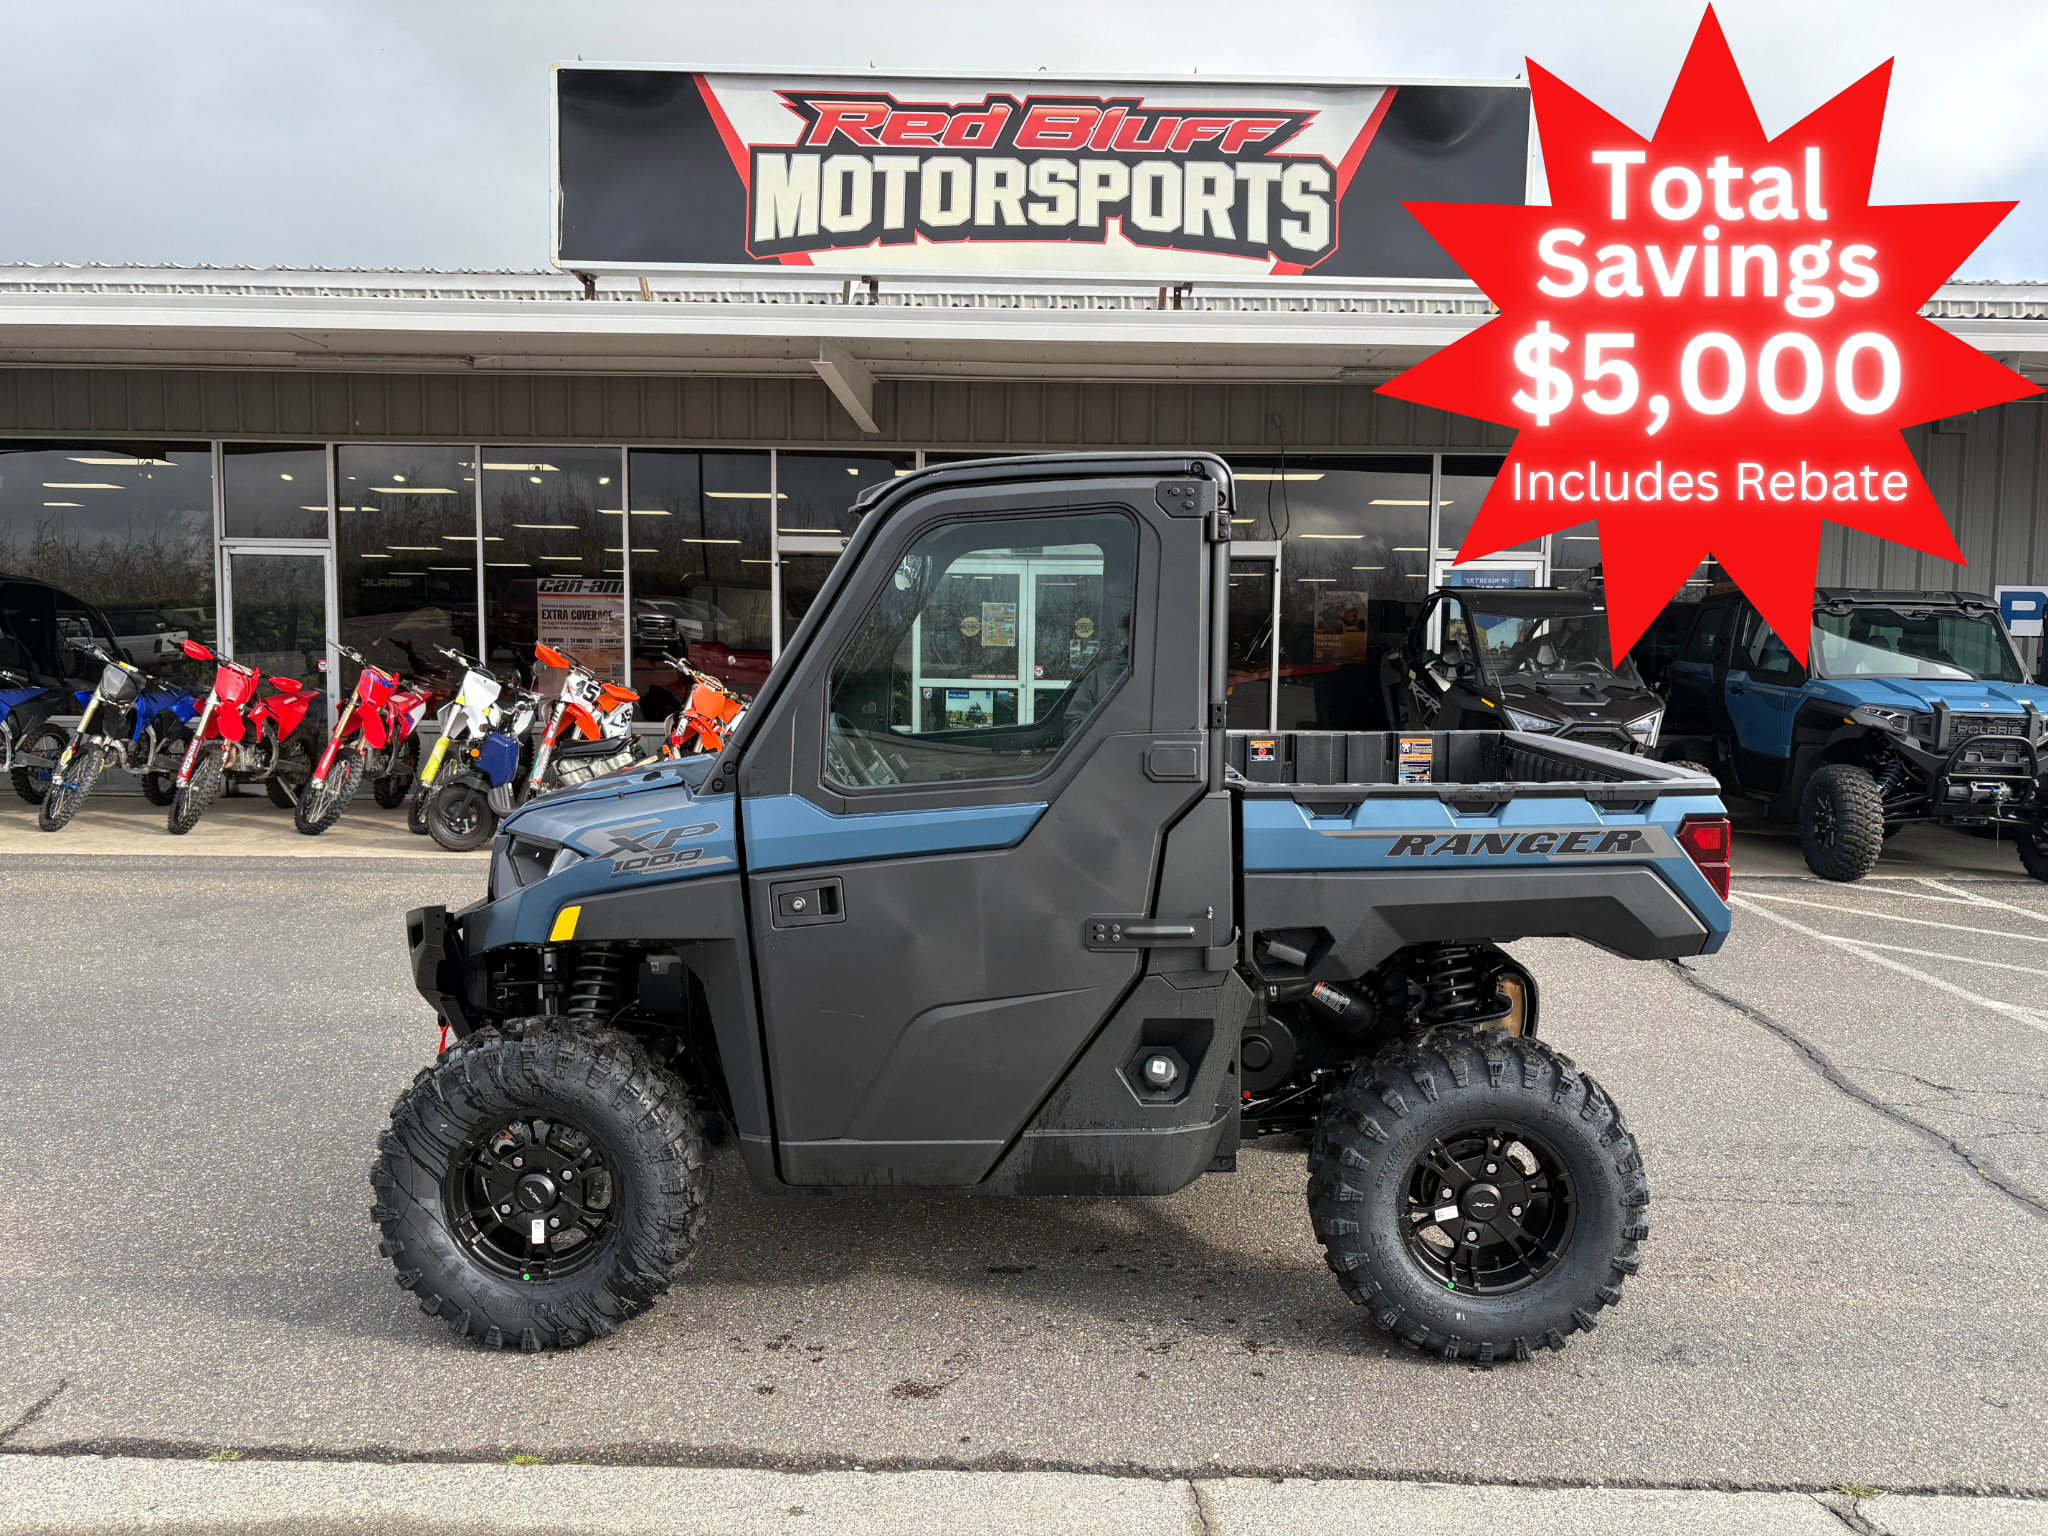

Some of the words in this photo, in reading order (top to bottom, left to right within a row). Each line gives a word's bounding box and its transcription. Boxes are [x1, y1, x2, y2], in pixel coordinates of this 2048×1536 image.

[804, 99, 1012, 151] Red
[753, 152, 1333, 253] MOTORSPORTS
[541, 609, 568, 620] EXTRA
[571, 609, 614, 621] COVERAGE
[1957, 724, 2022, 735] POLARIS
[585, 821, 722, 864] XP
[1384, 830, 1643, 858] RANGER
[610, 848, 704, 874] 1000
